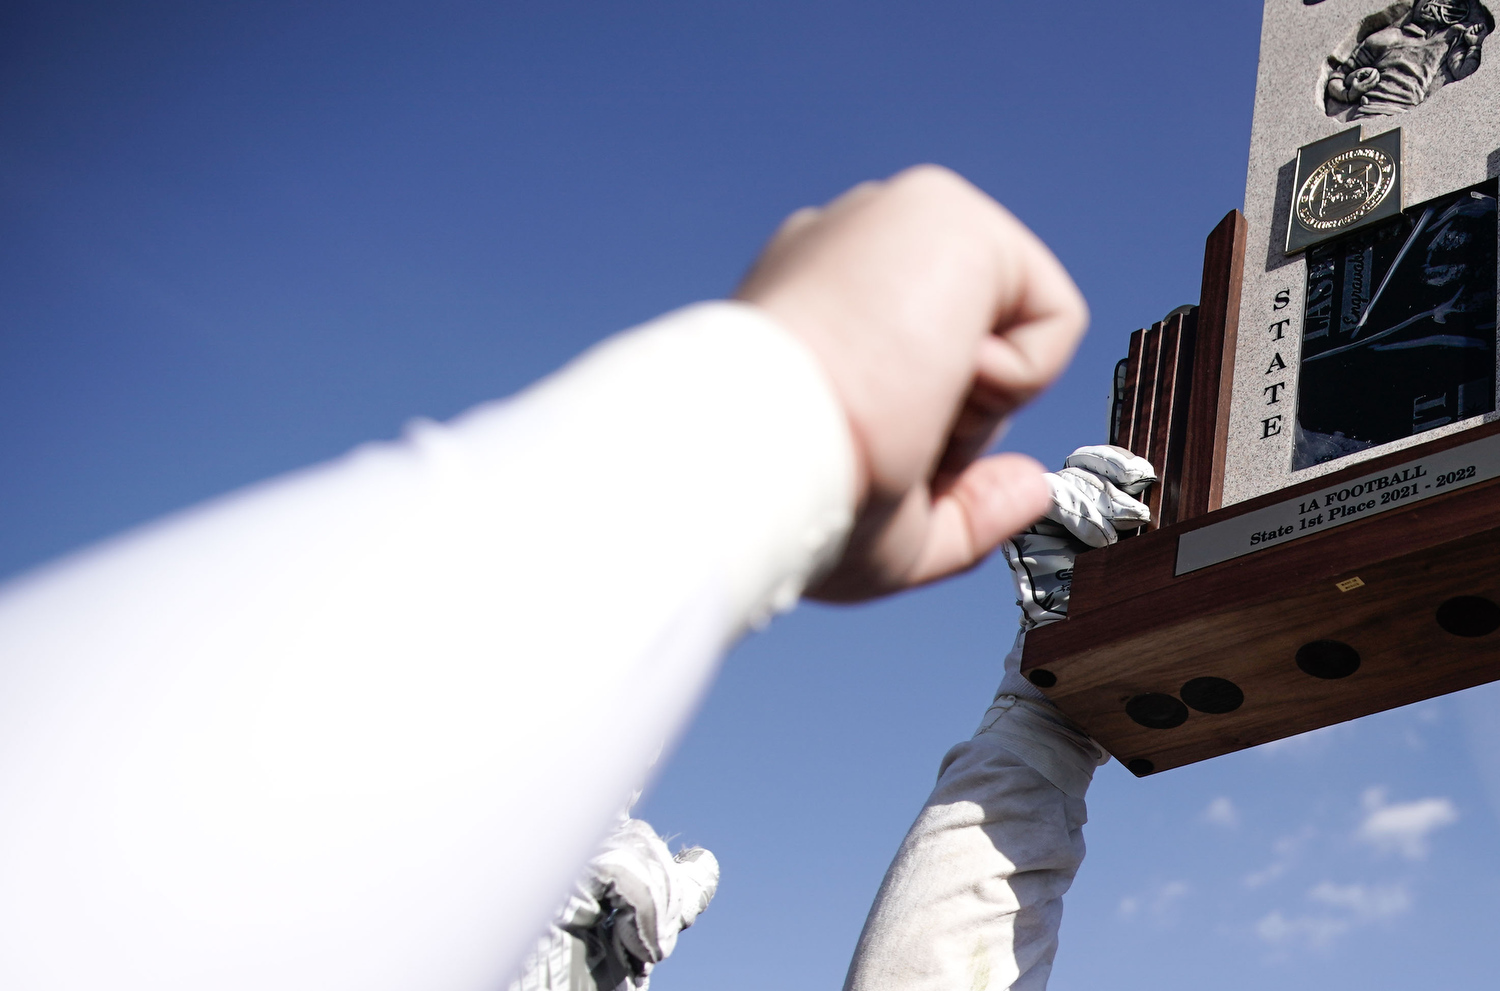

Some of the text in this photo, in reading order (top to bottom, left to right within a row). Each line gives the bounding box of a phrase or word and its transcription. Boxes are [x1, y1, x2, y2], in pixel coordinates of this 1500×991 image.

[1259, 288, 1290, 440] STATE
[1250, 525, 1294, 546] State
[1299, 513, 1324, 531] 1st
[1328, 499, 1376, 521] Place
[1380, 483, 1419, 505] 2021
[1435, 465, 1476, 488] 2022
[1298, 465, 1427, 515] 1A FOOTBALL
